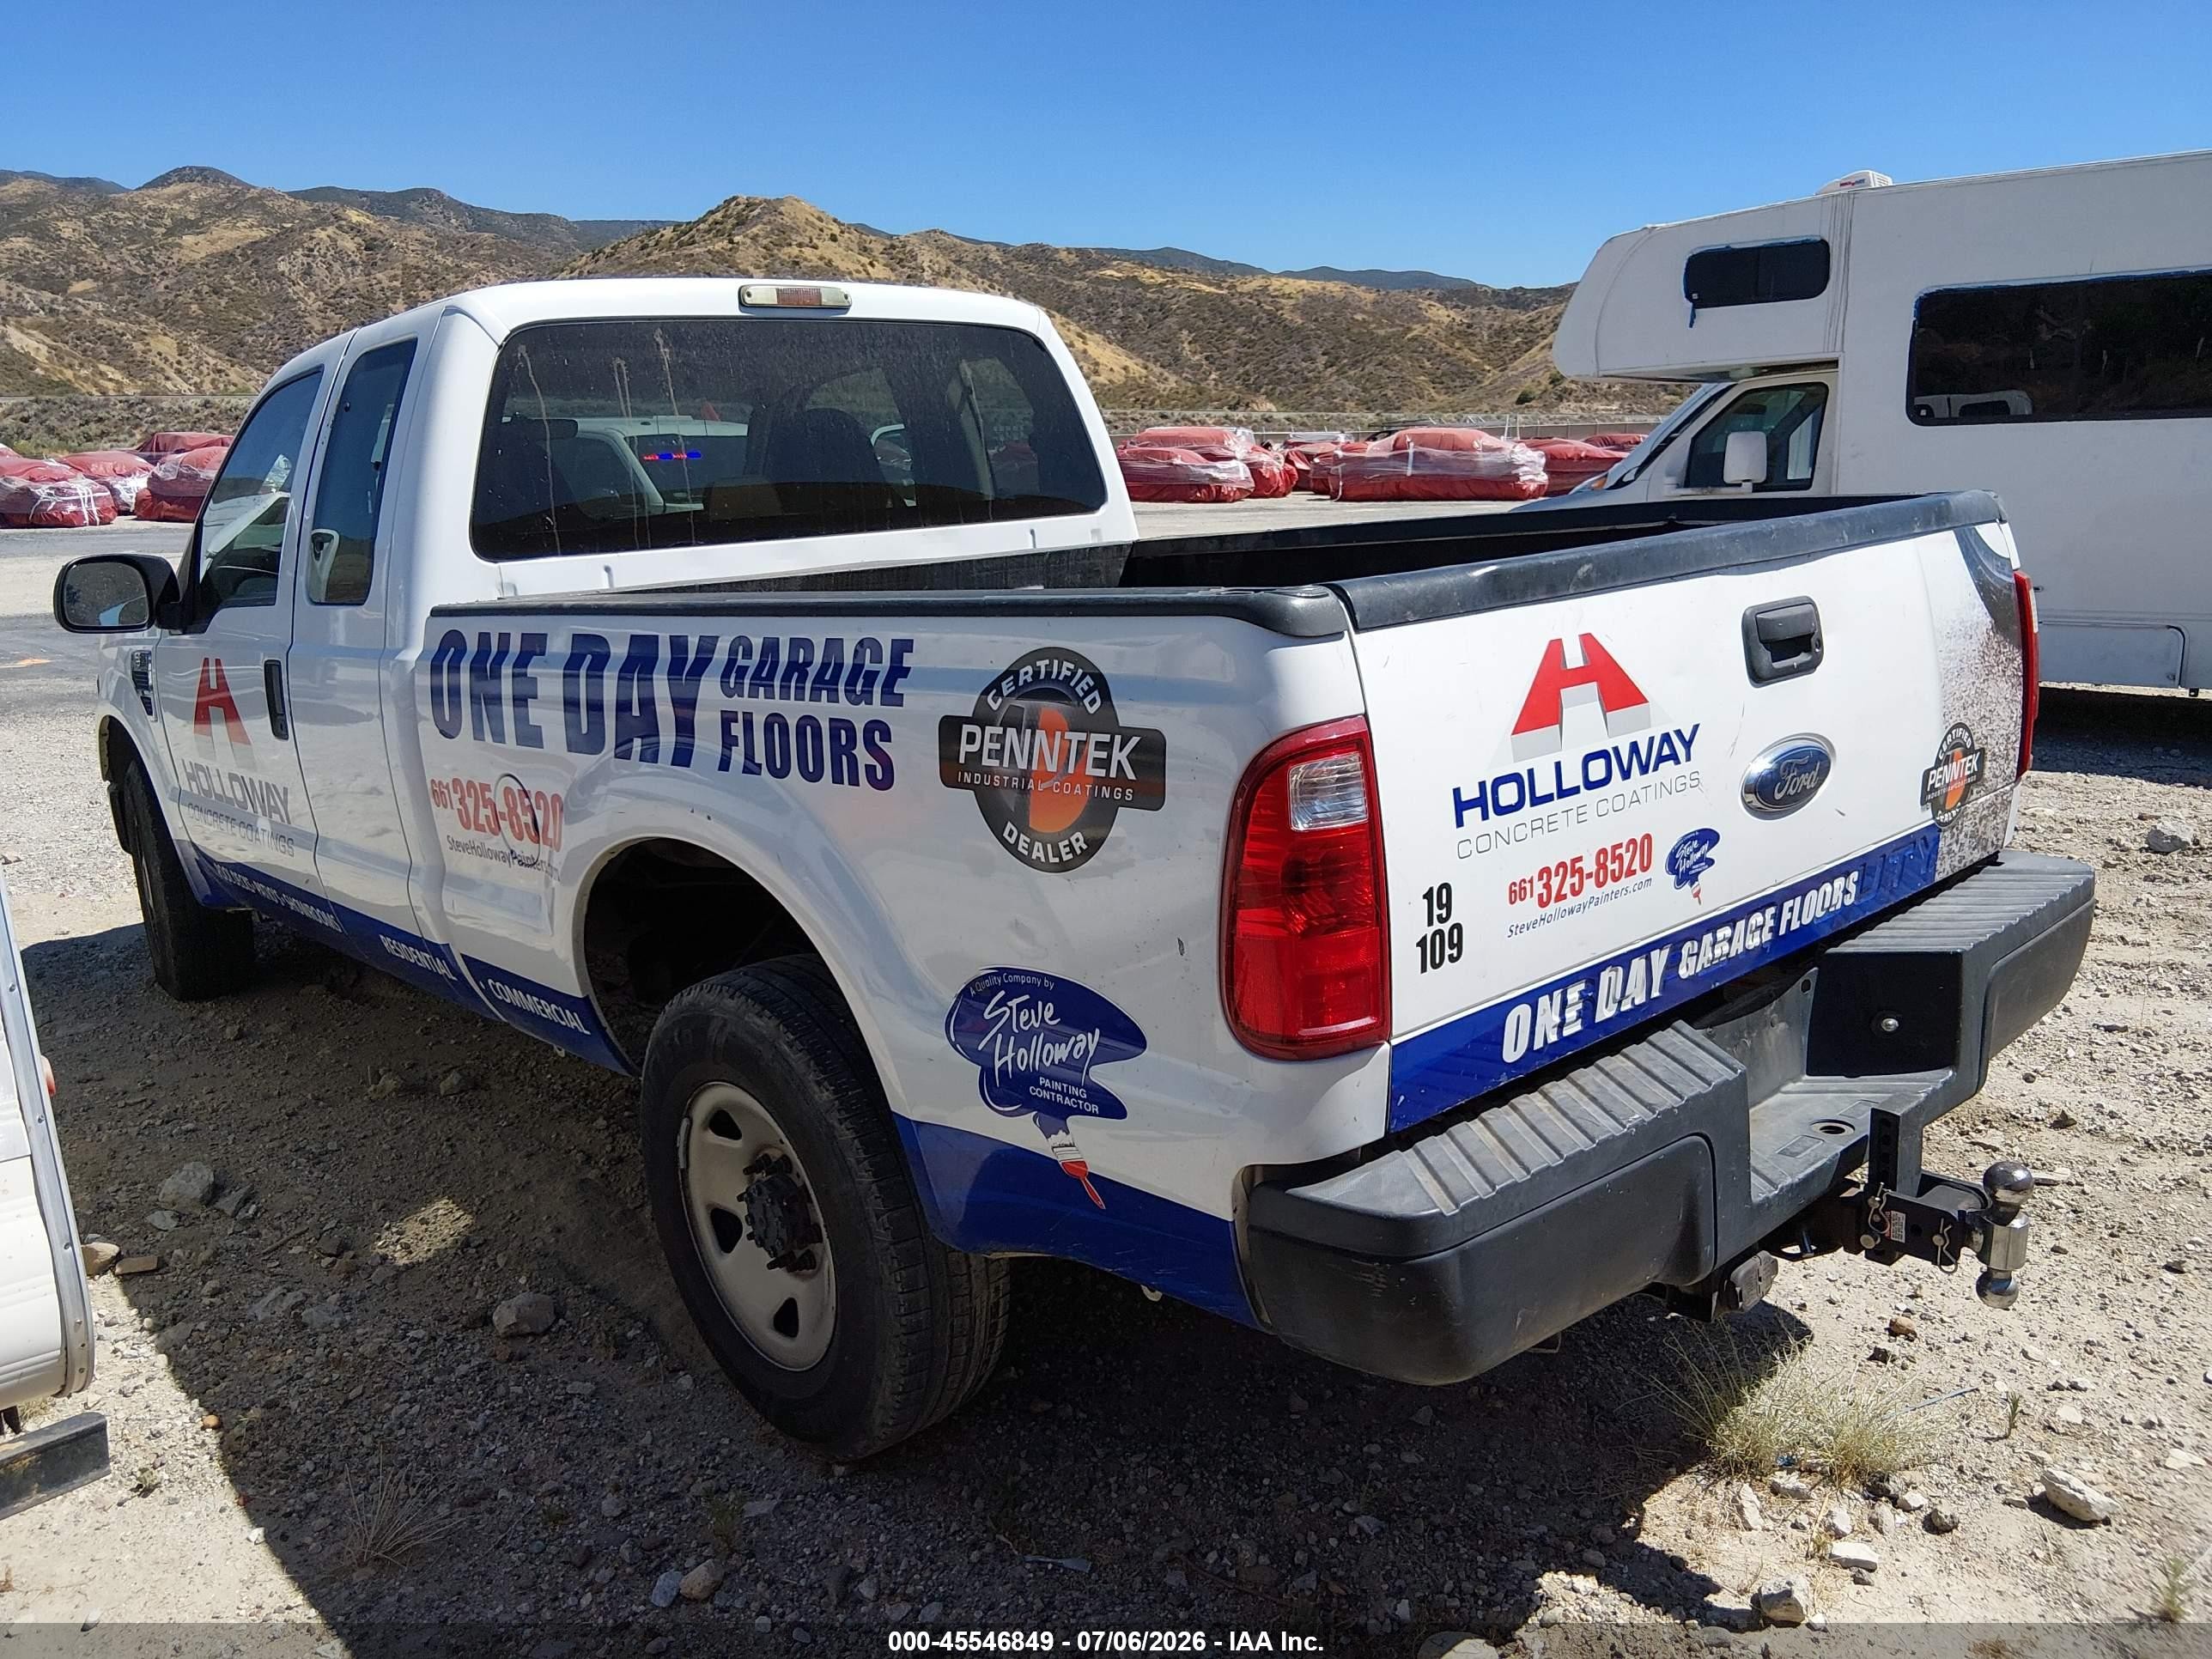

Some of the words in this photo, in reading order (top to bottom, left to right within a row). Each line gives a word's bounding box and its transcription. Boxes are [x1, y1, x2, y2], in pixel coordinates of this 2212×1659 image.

[430, 629, 548, 750] ONE
[562, 633, 720, 768] DAY
[719, 635, 914, 707] GARAGE
[987, 659, 1102, 714] CERTIFIED
[717, 710, 895, 791] FLOORS
[958, 724, 1142, 781] PENNTEK
[1927, 751, 1980, 792] PENNTEK
[1939, 727, 1972, 760] CERTIFIED
[181, 758, 292, 825] HOLLOWAY
[958, 771, 1044, 792] INDUSTRIAL
[1053, 782, 1133, 801] COATINGS
[1453, 723, 1700, 829] HOLLOWAY
[1773, 755, 1822, 801] Ford
[187, 802, 236, 836] CONCRETE
[239, 820, 295, 858] COATINGS
[430, 778, 453, 810] 661
[452, 777, 563, 853] 325-8520
[1002, 821, 1088, 863] DEALER
[1457, 803, 1589, 860] CONCRETE
[1596, 770, 1700, 818] COATINGS
[1508, 875, 1534, 905] 661
[1537, 832, 1653, 909] 325-8520
[1422, 882, 1453, 927] 19
[1507, 877, 1653, 939] SteveHollowayPainters.com
[379, 933, 458, 981] RESIDENTIAL
[1415, 922, 1464, 975] 109
[1503, 979, 1586, 1063] ONE
[1595, 944, 1674, 1024] DAY
[1678, 905, 1778, 980] GARAGE
[1778, 871, 1858, 936] FLOORS
[487, 978, 592, 1036] COMMERCIAL
[969, 987, 975, 998] A
[975, 975, 1001, 992] Quality
[1003, 973, 1042, 988] Company
[1043, 977, 1054, 990] by
[978, 989, 1061, 1051] Steve
[994, 1028, 1100, 1088] Holloway
[1029, 1086, 1099, 1115] CONTRACTOR
[1039, 1077, 1087, 1099] PAINTING
